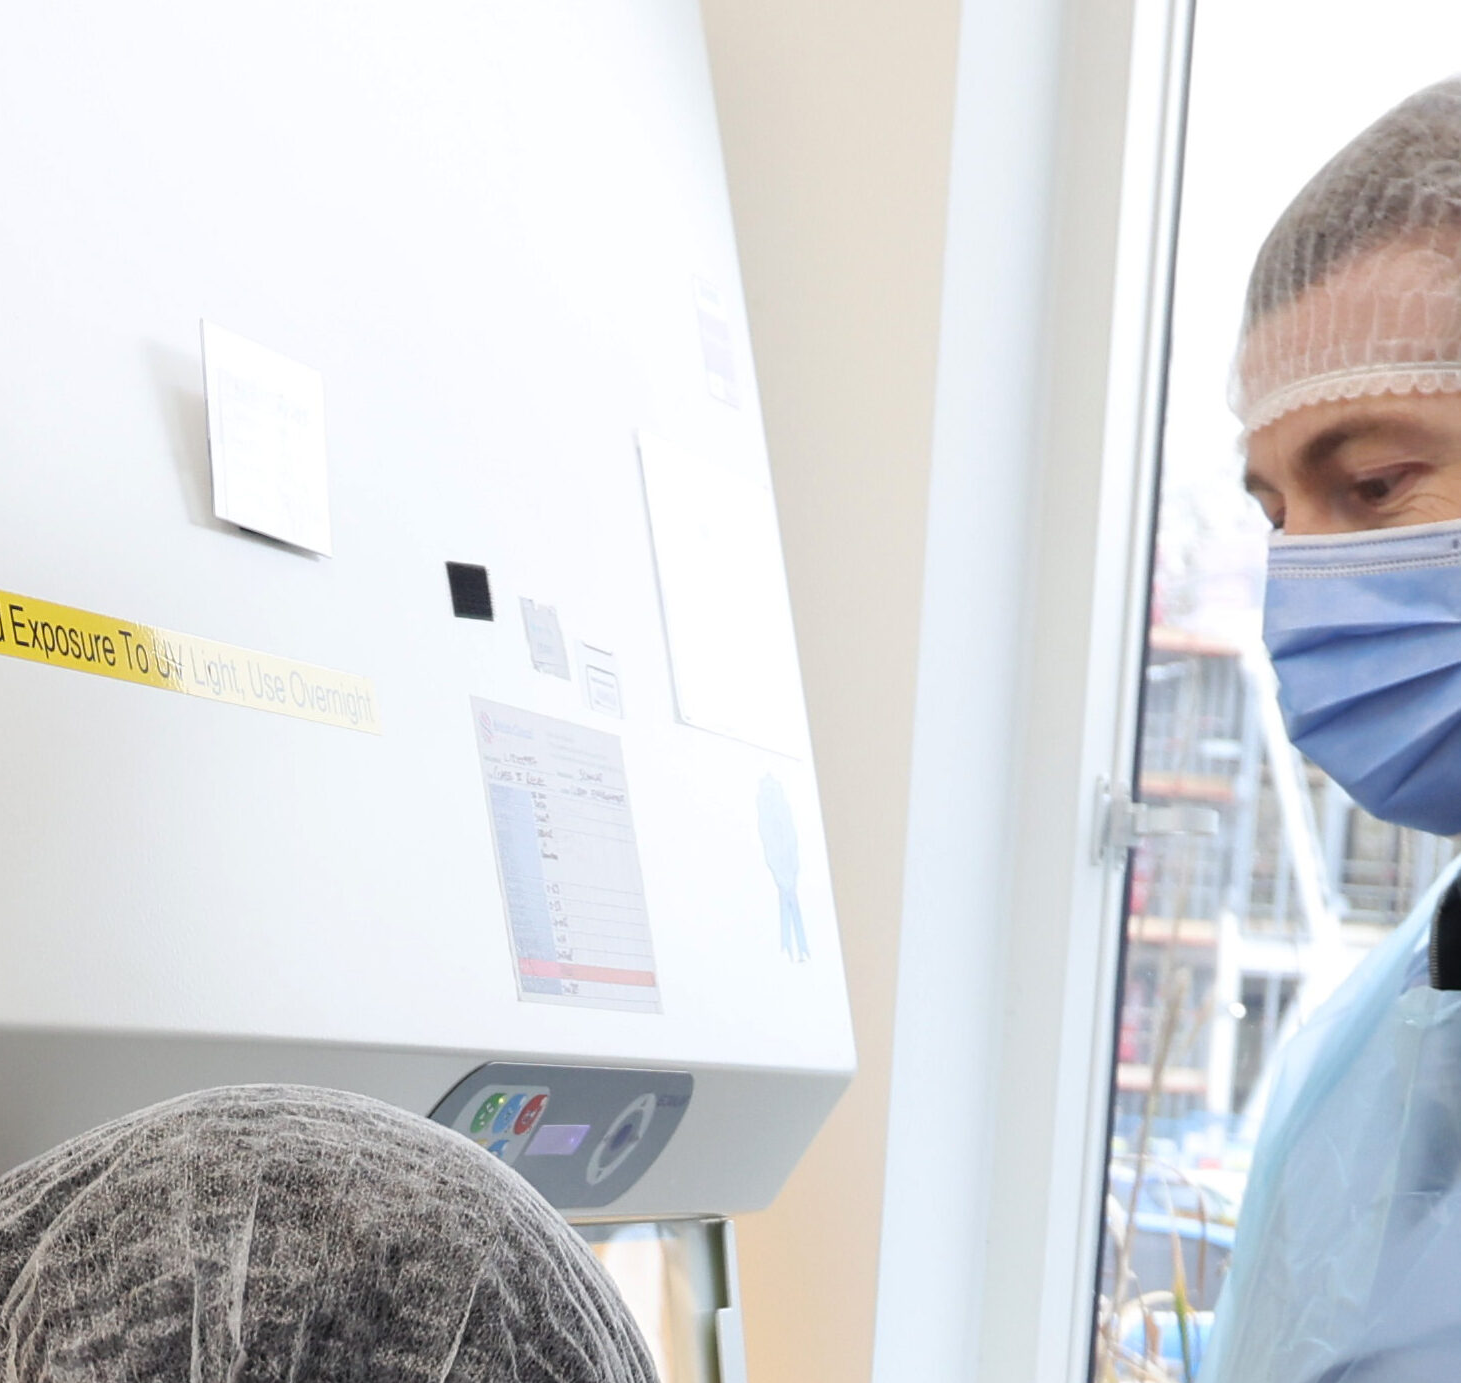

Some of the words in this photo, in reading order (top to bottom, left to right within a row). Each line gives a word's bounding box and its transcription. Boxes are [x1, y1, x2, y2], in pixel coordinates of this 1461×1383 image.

[11, 606, 117, 667] Exposure
[118, 629, 149, 674] To
[153, 637, 183, 682] UV
[246, 659, 287, 705] Use
[289, 670, 377, 725] Overnight
